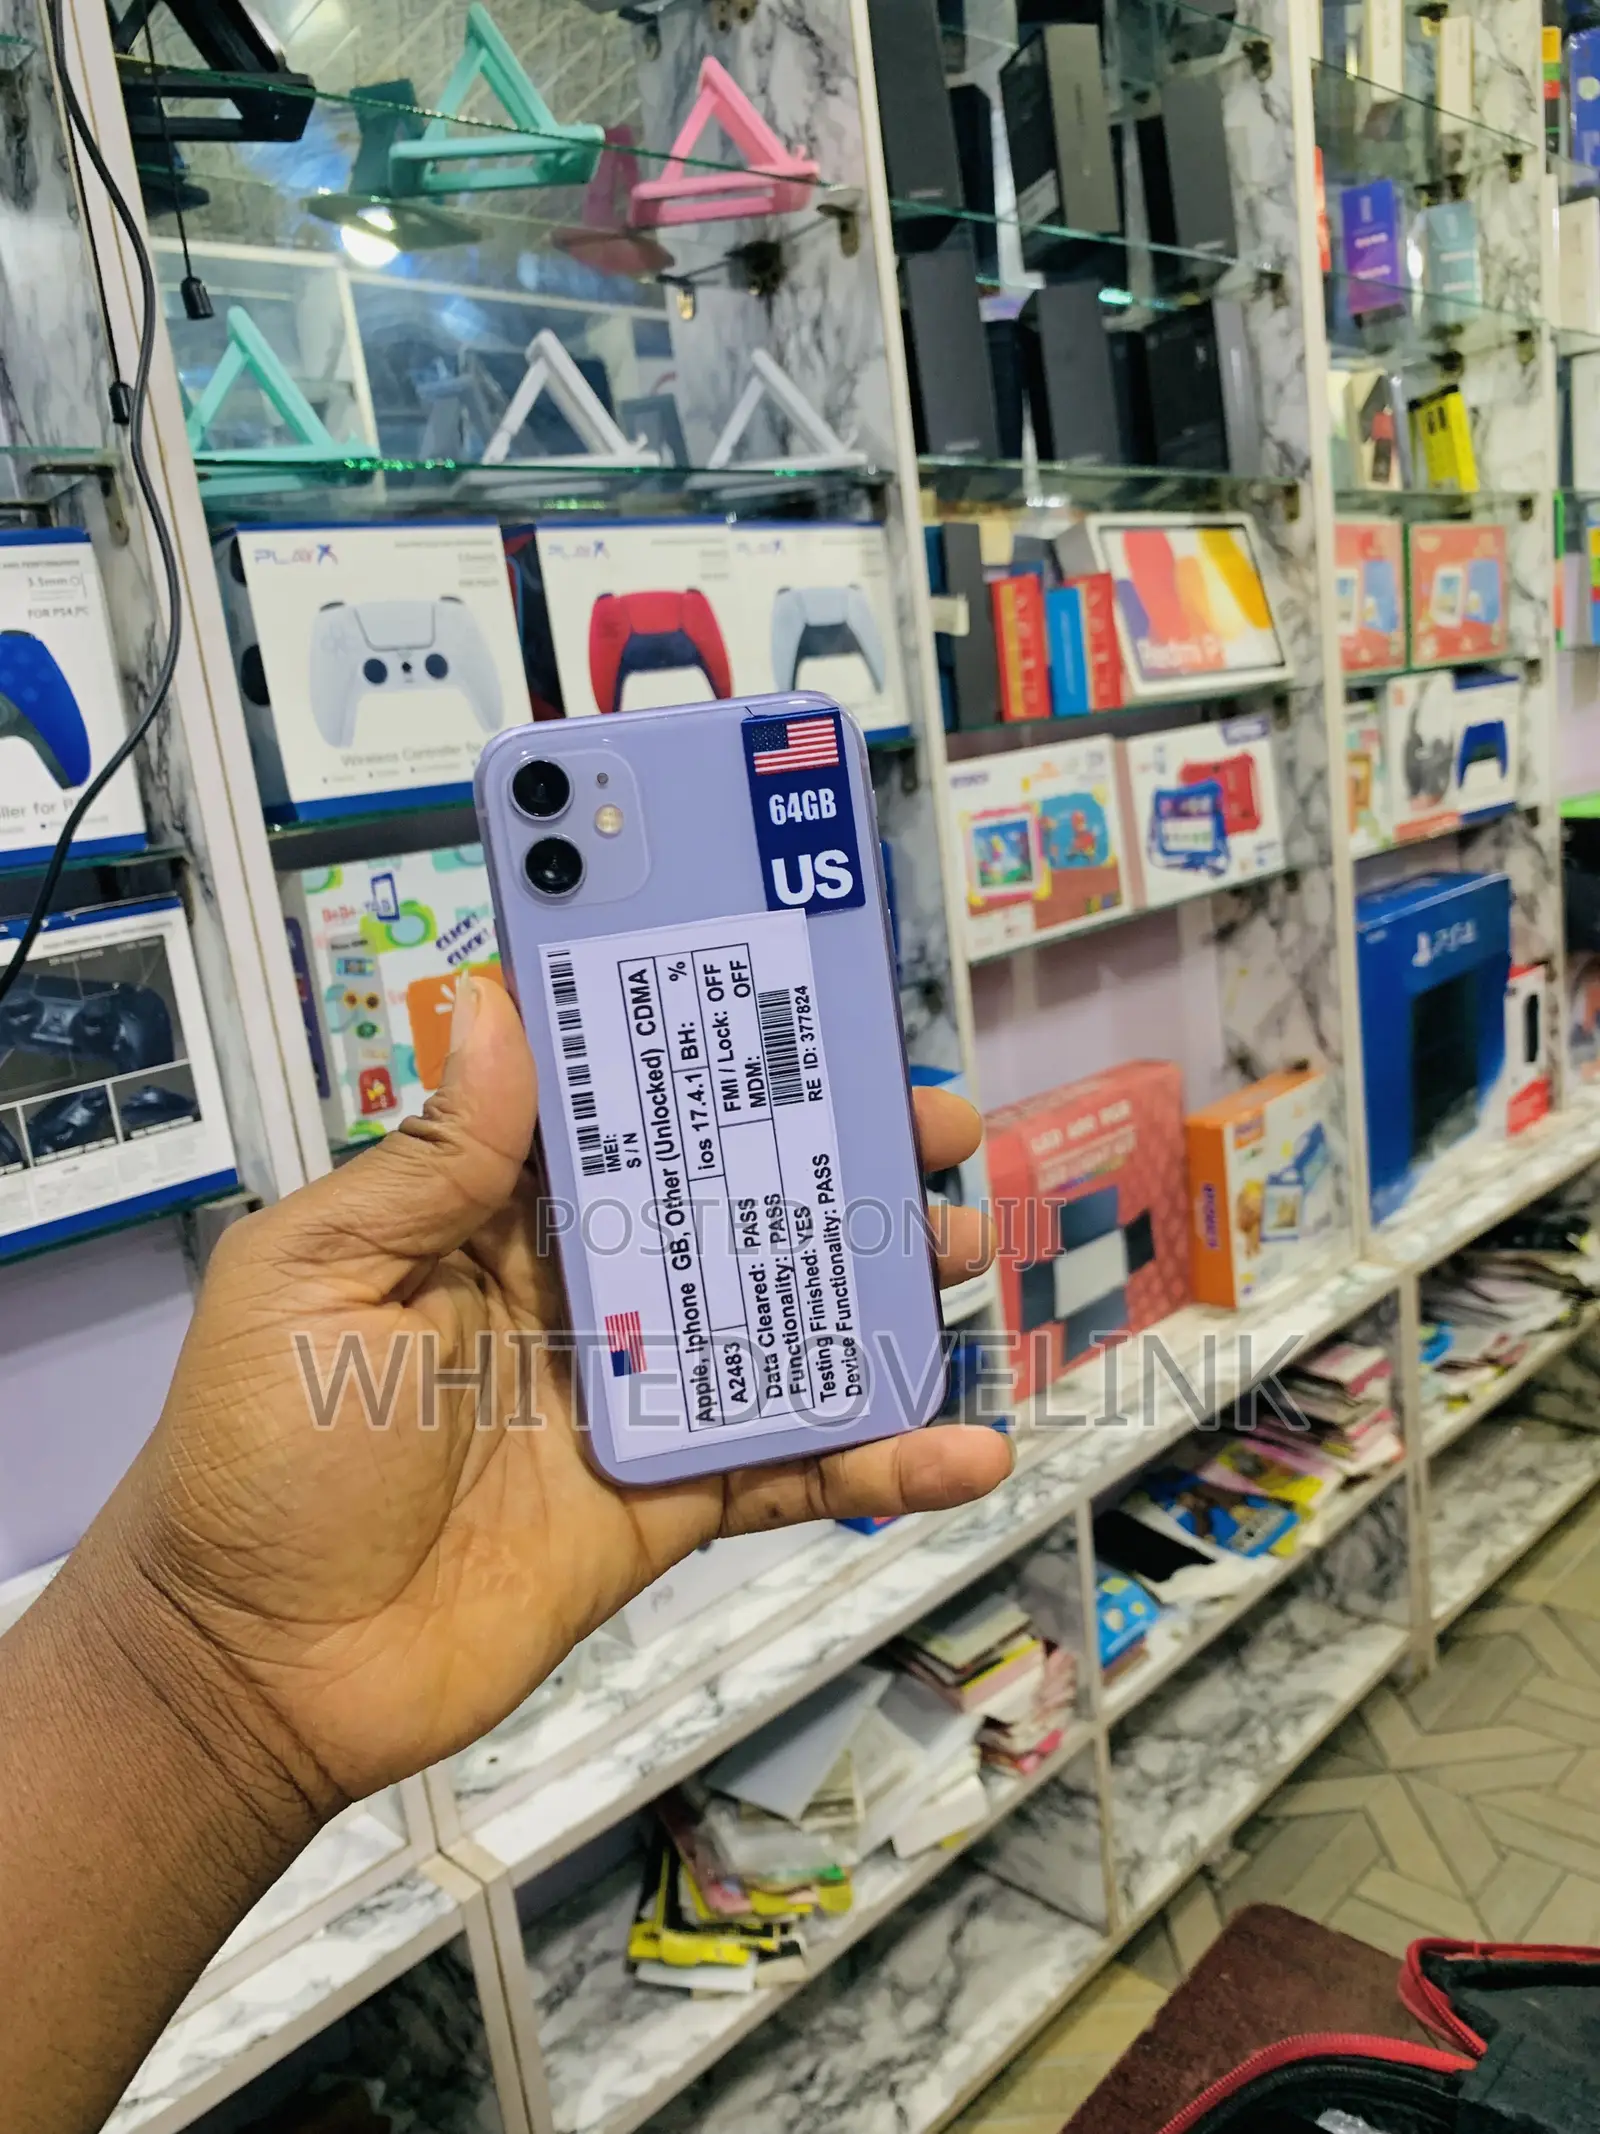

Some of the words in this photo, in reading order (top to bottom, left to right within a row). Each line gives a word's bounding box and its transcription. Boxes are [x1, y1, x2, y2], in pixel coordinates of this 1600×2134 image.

[34, 801, 57, 815] for
[769, 788, 837, 825] 64GB
[771, 849, 854, 905] US
[667, 961, 687, 982] %
[703, 964, 724, 1002] OFF
[729, 960, 751, 999] OFF
[628, 968, 656, 1037] CDMA
[794, 985, 815, 1043] 377824
[677, 1022, 699, 1061] BH:
[712, 1010, 734, 1063] Lock:
[803, 1047, 819, 1070] ID:
[640, 1048, 682, 1163] (Unlocked)
[684, 1073, 710, 1132] 17.4.1
[720, 1079, 741, 1112] FMI
[745, 1055, 767, 1108] MDM:
[807, 1078, 824, 1102] RE
[604, 1134, 622, 1173] IMEI:
[623, 1133, 638, 1145] N
[626, 1157, 643, 1169] S
[663, 1168, 685, 1226] Other
[812, 1152, 836, 1205] PASS
[738, 1197, 761, 1249] PASS
[764, 1192, 787, 1244] PASS
[794, 1205, 815, 1245] YES
[670, 1231, 692, 1271] GB,
[823, 1209, 853, 1332] Functionality:
[749, 1262, 776, 1349] Cleared:
[800, 1247, 828, 1333] Finished:
[680, 1282, 709, 1354] Iphone
[775, 1256, 807, 1396] Functionality:
[690, 1357, 718, 1423] Apple,
[724, 1341, 748, 1404] A2483
[764, 1352, 784, 1400] Data
[816, 1335, 838, 1403] Testing
[841, 1337, 863, 1398] Device
